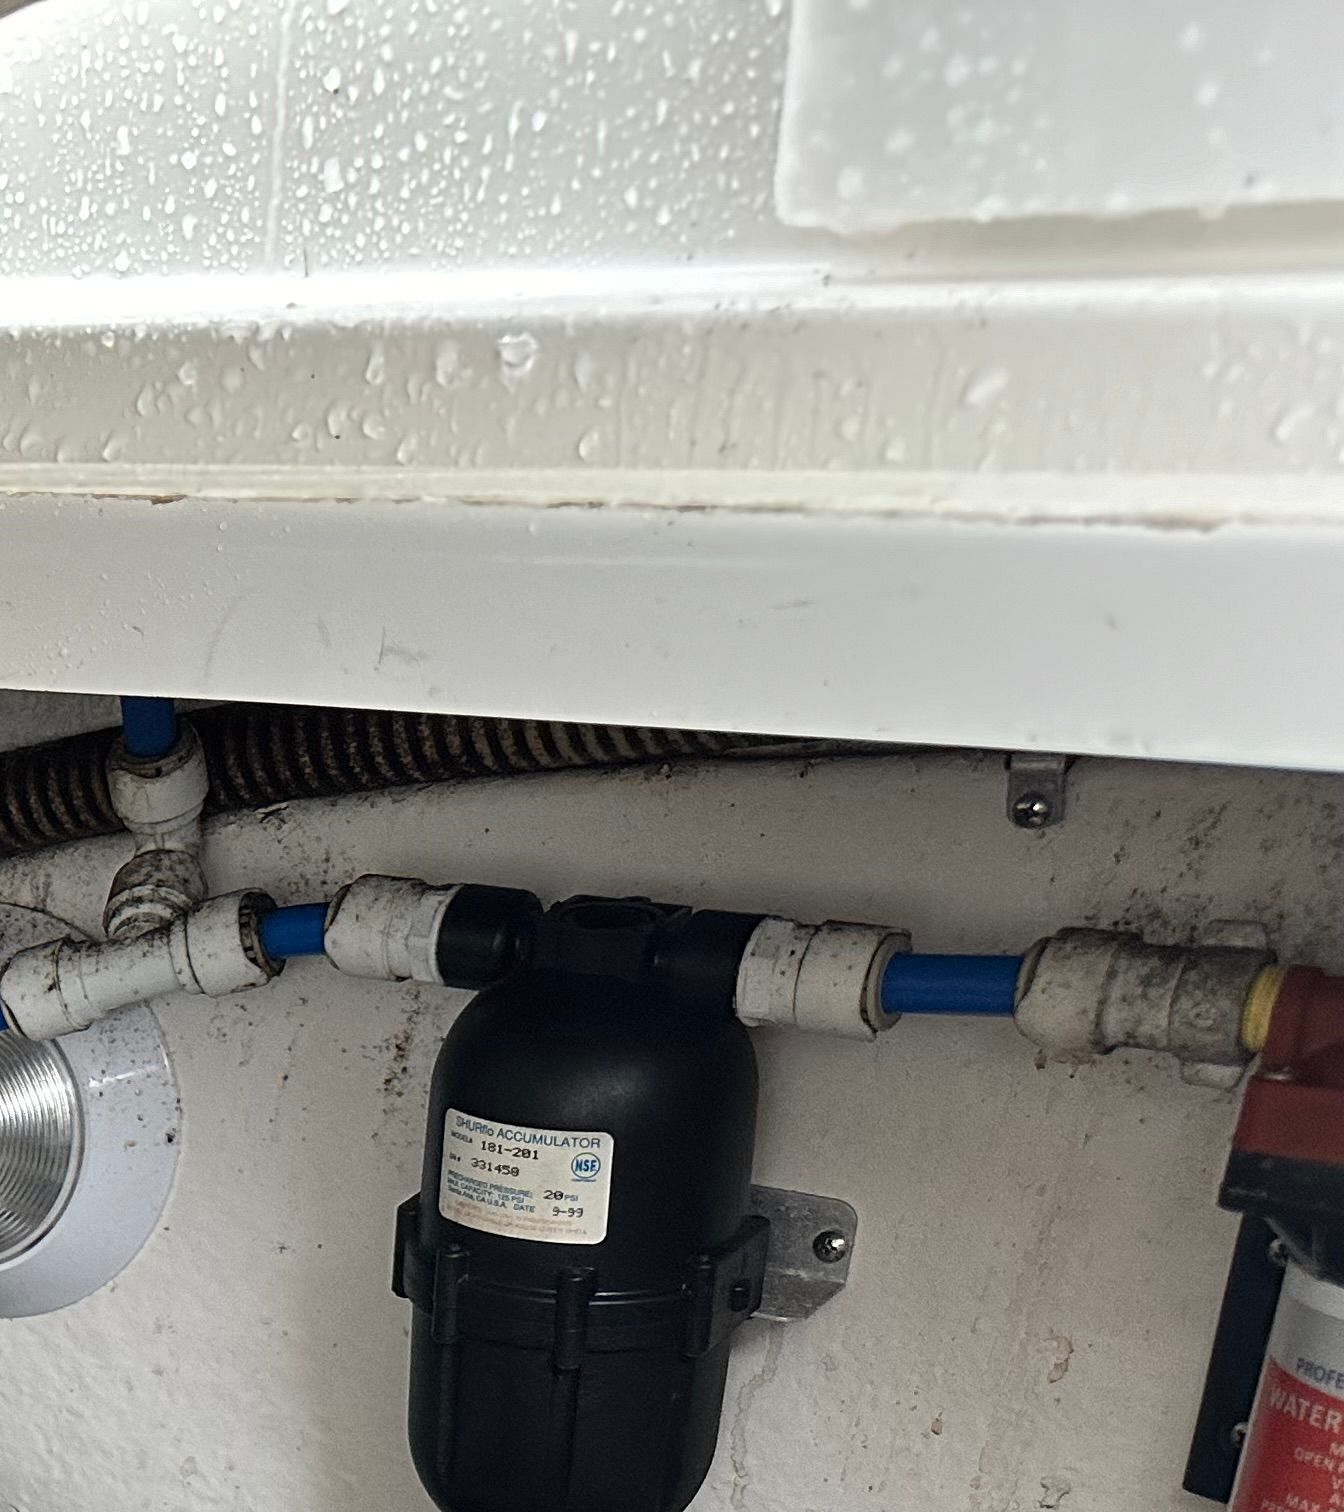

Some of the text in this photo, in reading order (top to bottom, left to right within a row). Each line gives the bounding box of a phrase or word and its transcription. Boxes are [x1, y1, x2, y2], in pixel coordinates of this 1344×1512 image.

[497, 1128, 601, 1149] ACCUMULATOR
[480, 1140, 539, 1160] 181-201
[543, 1190, 564, 1201] 20
[513, 1204, 536, 1213] DATE
[552, 1206, 584, 1218] 9-99
[1268, 1387, 1343, 1434] WATER
